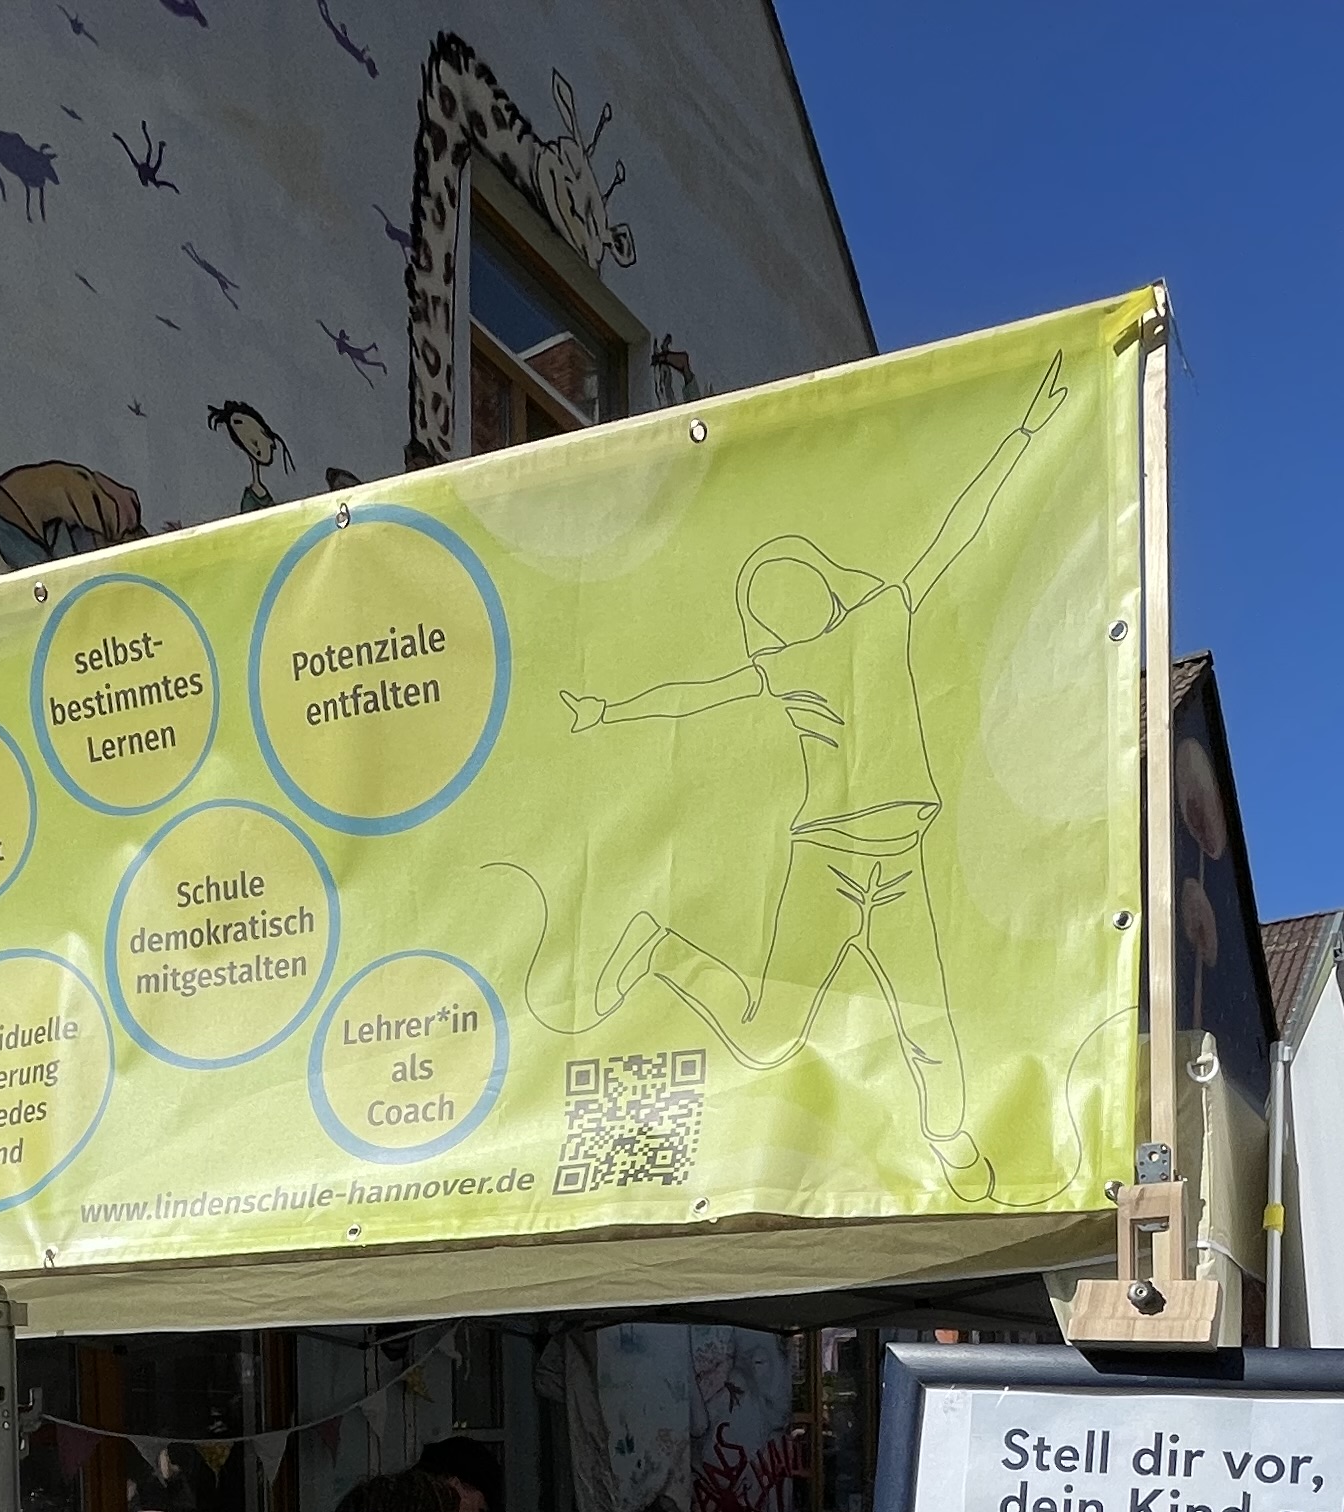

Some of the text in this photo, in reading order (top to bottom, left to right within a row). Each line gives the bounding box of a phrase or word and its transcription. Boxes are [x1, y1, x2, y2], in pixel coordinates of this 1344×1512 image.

[73, 631, 164, 675] selbst-
[292, 622, 447, 680] Potenziale
[50, 672, 204, 726] bestimmtes
[306, 676, 442, 728] entfalten
[87, 725, 177, 764] Lernen
[177, 872, 265, 908] Schule
[129, 909, 315, 955] demokratisch
[135, 954, 308, 999] mitgestalten
[391, 1054, 434, 1083] als
[366, 1097, 455, 1126] Coach
[80, 1169, 535, 1224] www.lindenschule-hannover.de
[1001, 1428, 1324, 1492] Stell dir vor,
